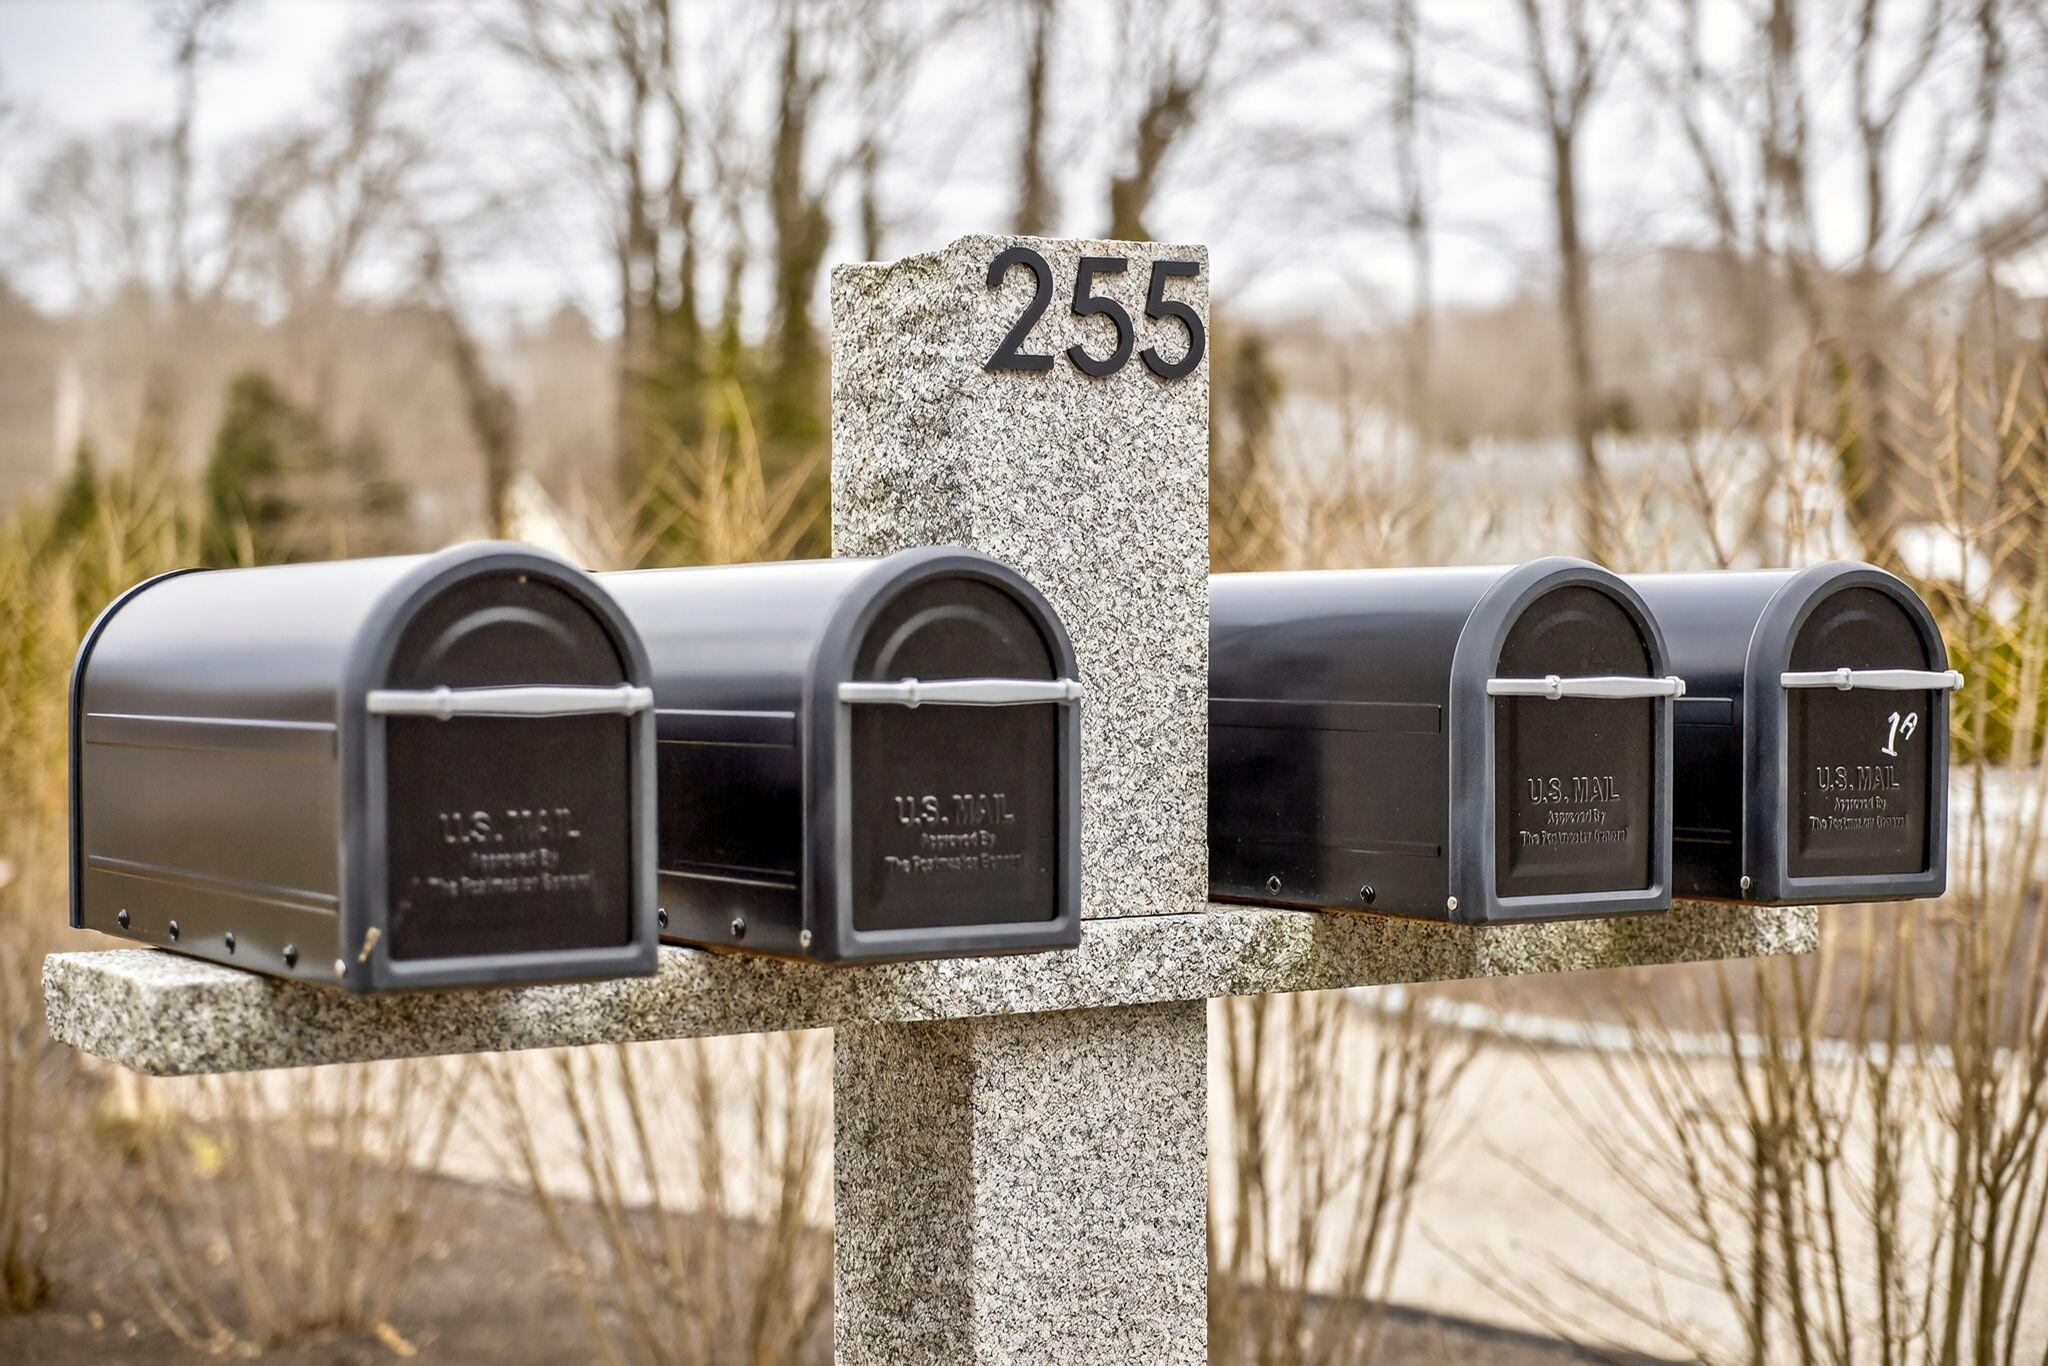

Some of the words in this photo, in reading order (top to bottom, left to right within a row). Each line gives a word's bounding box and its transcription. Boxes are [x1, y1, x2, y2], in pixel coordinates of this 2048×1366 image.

[984, 247, 1206, 379] 255
[1881, 711, 1918, 757] 1A
[1528, 777, 1569, 805] U.S.
[1572, 776, 1620, 803] MAIL
[1816, 766, 1854, 792] U.S.
[1857, 765, 1900, 791] MAIL
[440, 811, 503, 843] U.S.
[506, 808, 581, 841] MAIL
[895, 795, 949, 826] U.S.
[952, 793, 1015, 825] MAIL
